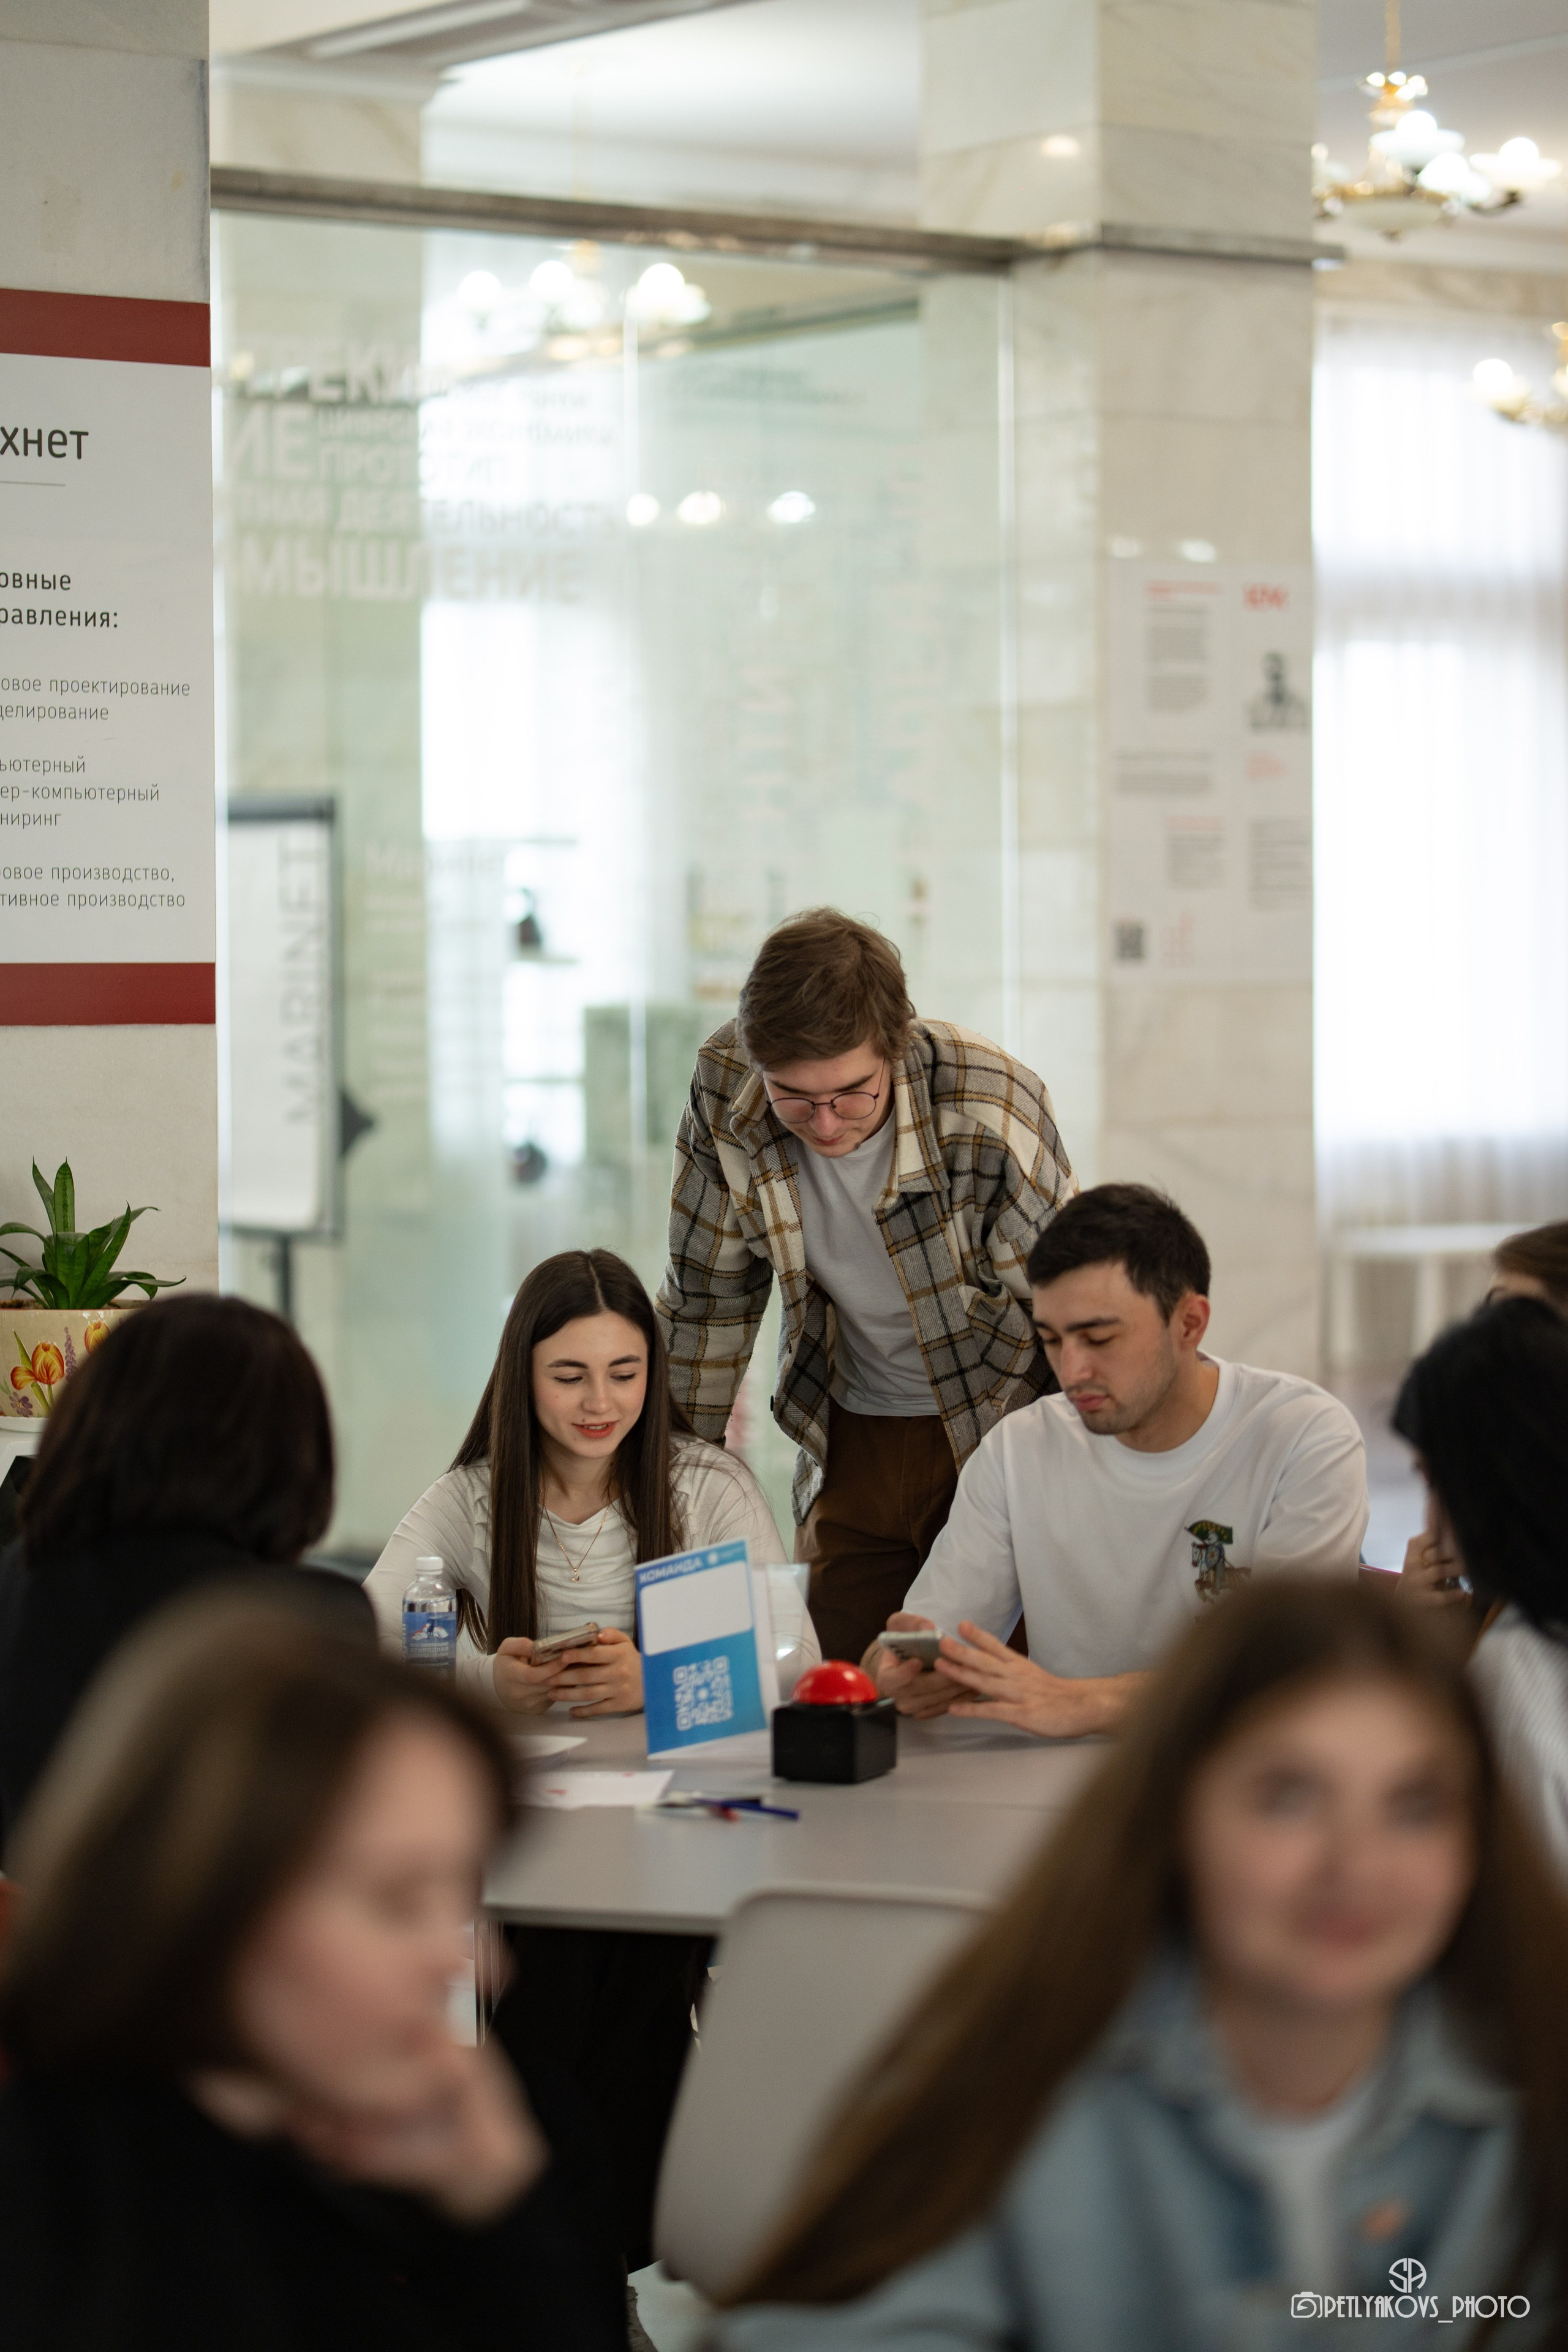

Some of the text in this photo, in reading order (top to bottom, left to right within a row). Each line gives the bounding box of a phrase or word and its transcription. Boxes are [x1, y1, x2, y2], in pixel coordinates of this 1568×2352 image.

[0, 426, 89, 459] хнет
[0, 571, 72, 590] овные
[1, 677, 190, 697] овое проектирование
[0, 755, 86, 777] ьютерный
[1, 783, 160, 804] ер-компьютерный
[1, 813, 62, 829] ниринг
[0, 866, 175, 884] овое производство,
[0, 894, 186, 910] тивное производство
[639, 1556, 704, 1584] КОМАНДА
